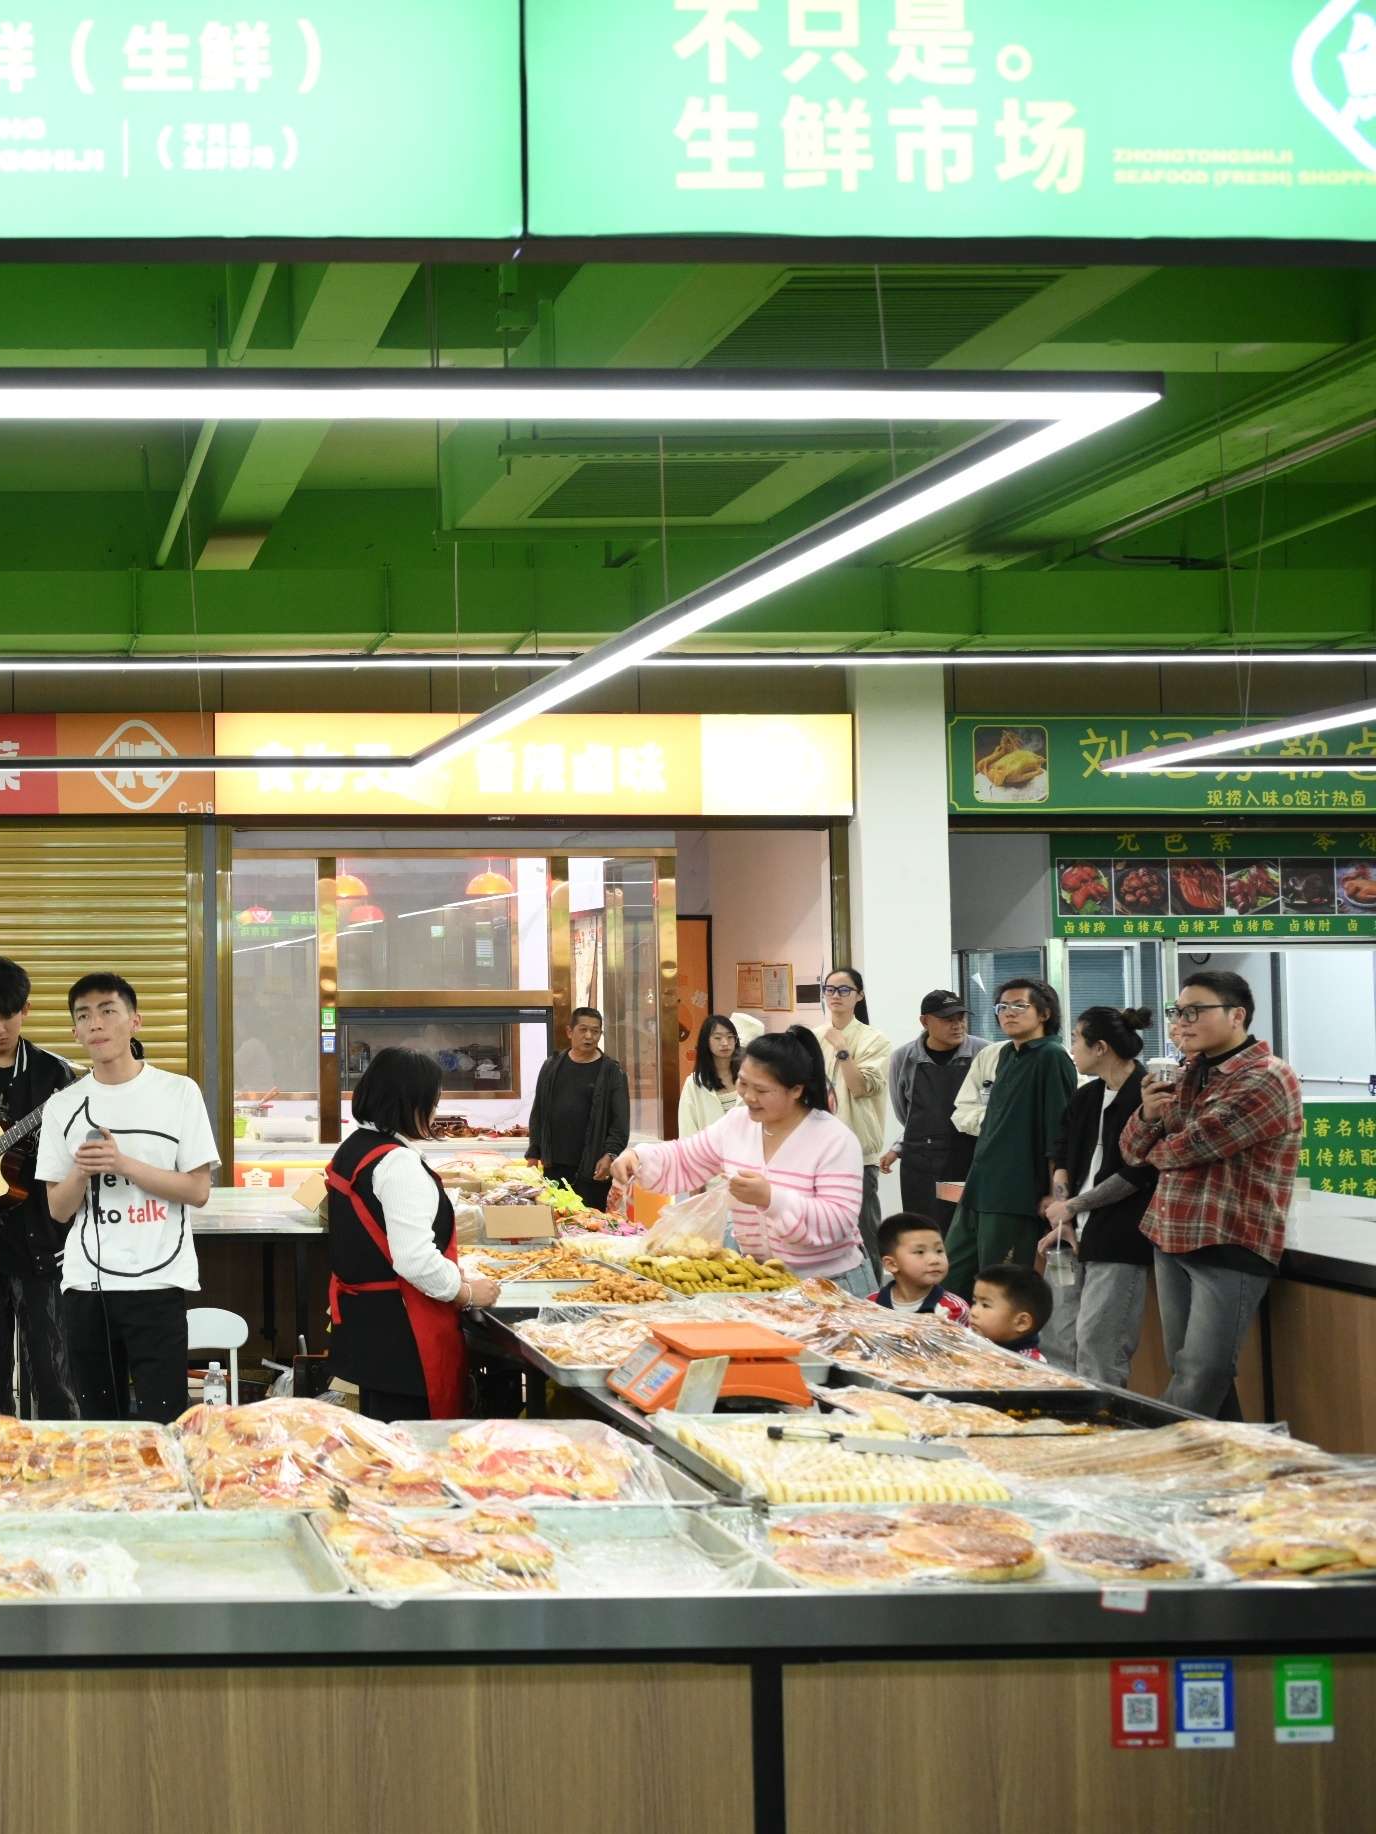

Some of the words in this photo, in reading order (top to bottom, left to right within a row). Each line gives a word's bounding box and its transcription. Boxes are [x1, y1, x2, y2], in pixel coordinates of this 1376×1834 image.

[673, 0, 1032, 85] 不只是。
[673, 96, 1086, 194] 生鲜市场
[1113, 169, 1209, 185] SEAFOOD
[1206, 789, 1279, 807] 现捞入味
[1294, 789, 1367, 807] 饱汁热卤
[1301, 1117, 1376, 1138] 著名特
[96, 1205, 122, 1224] to
[127, 1199, 167, 1224] talk
